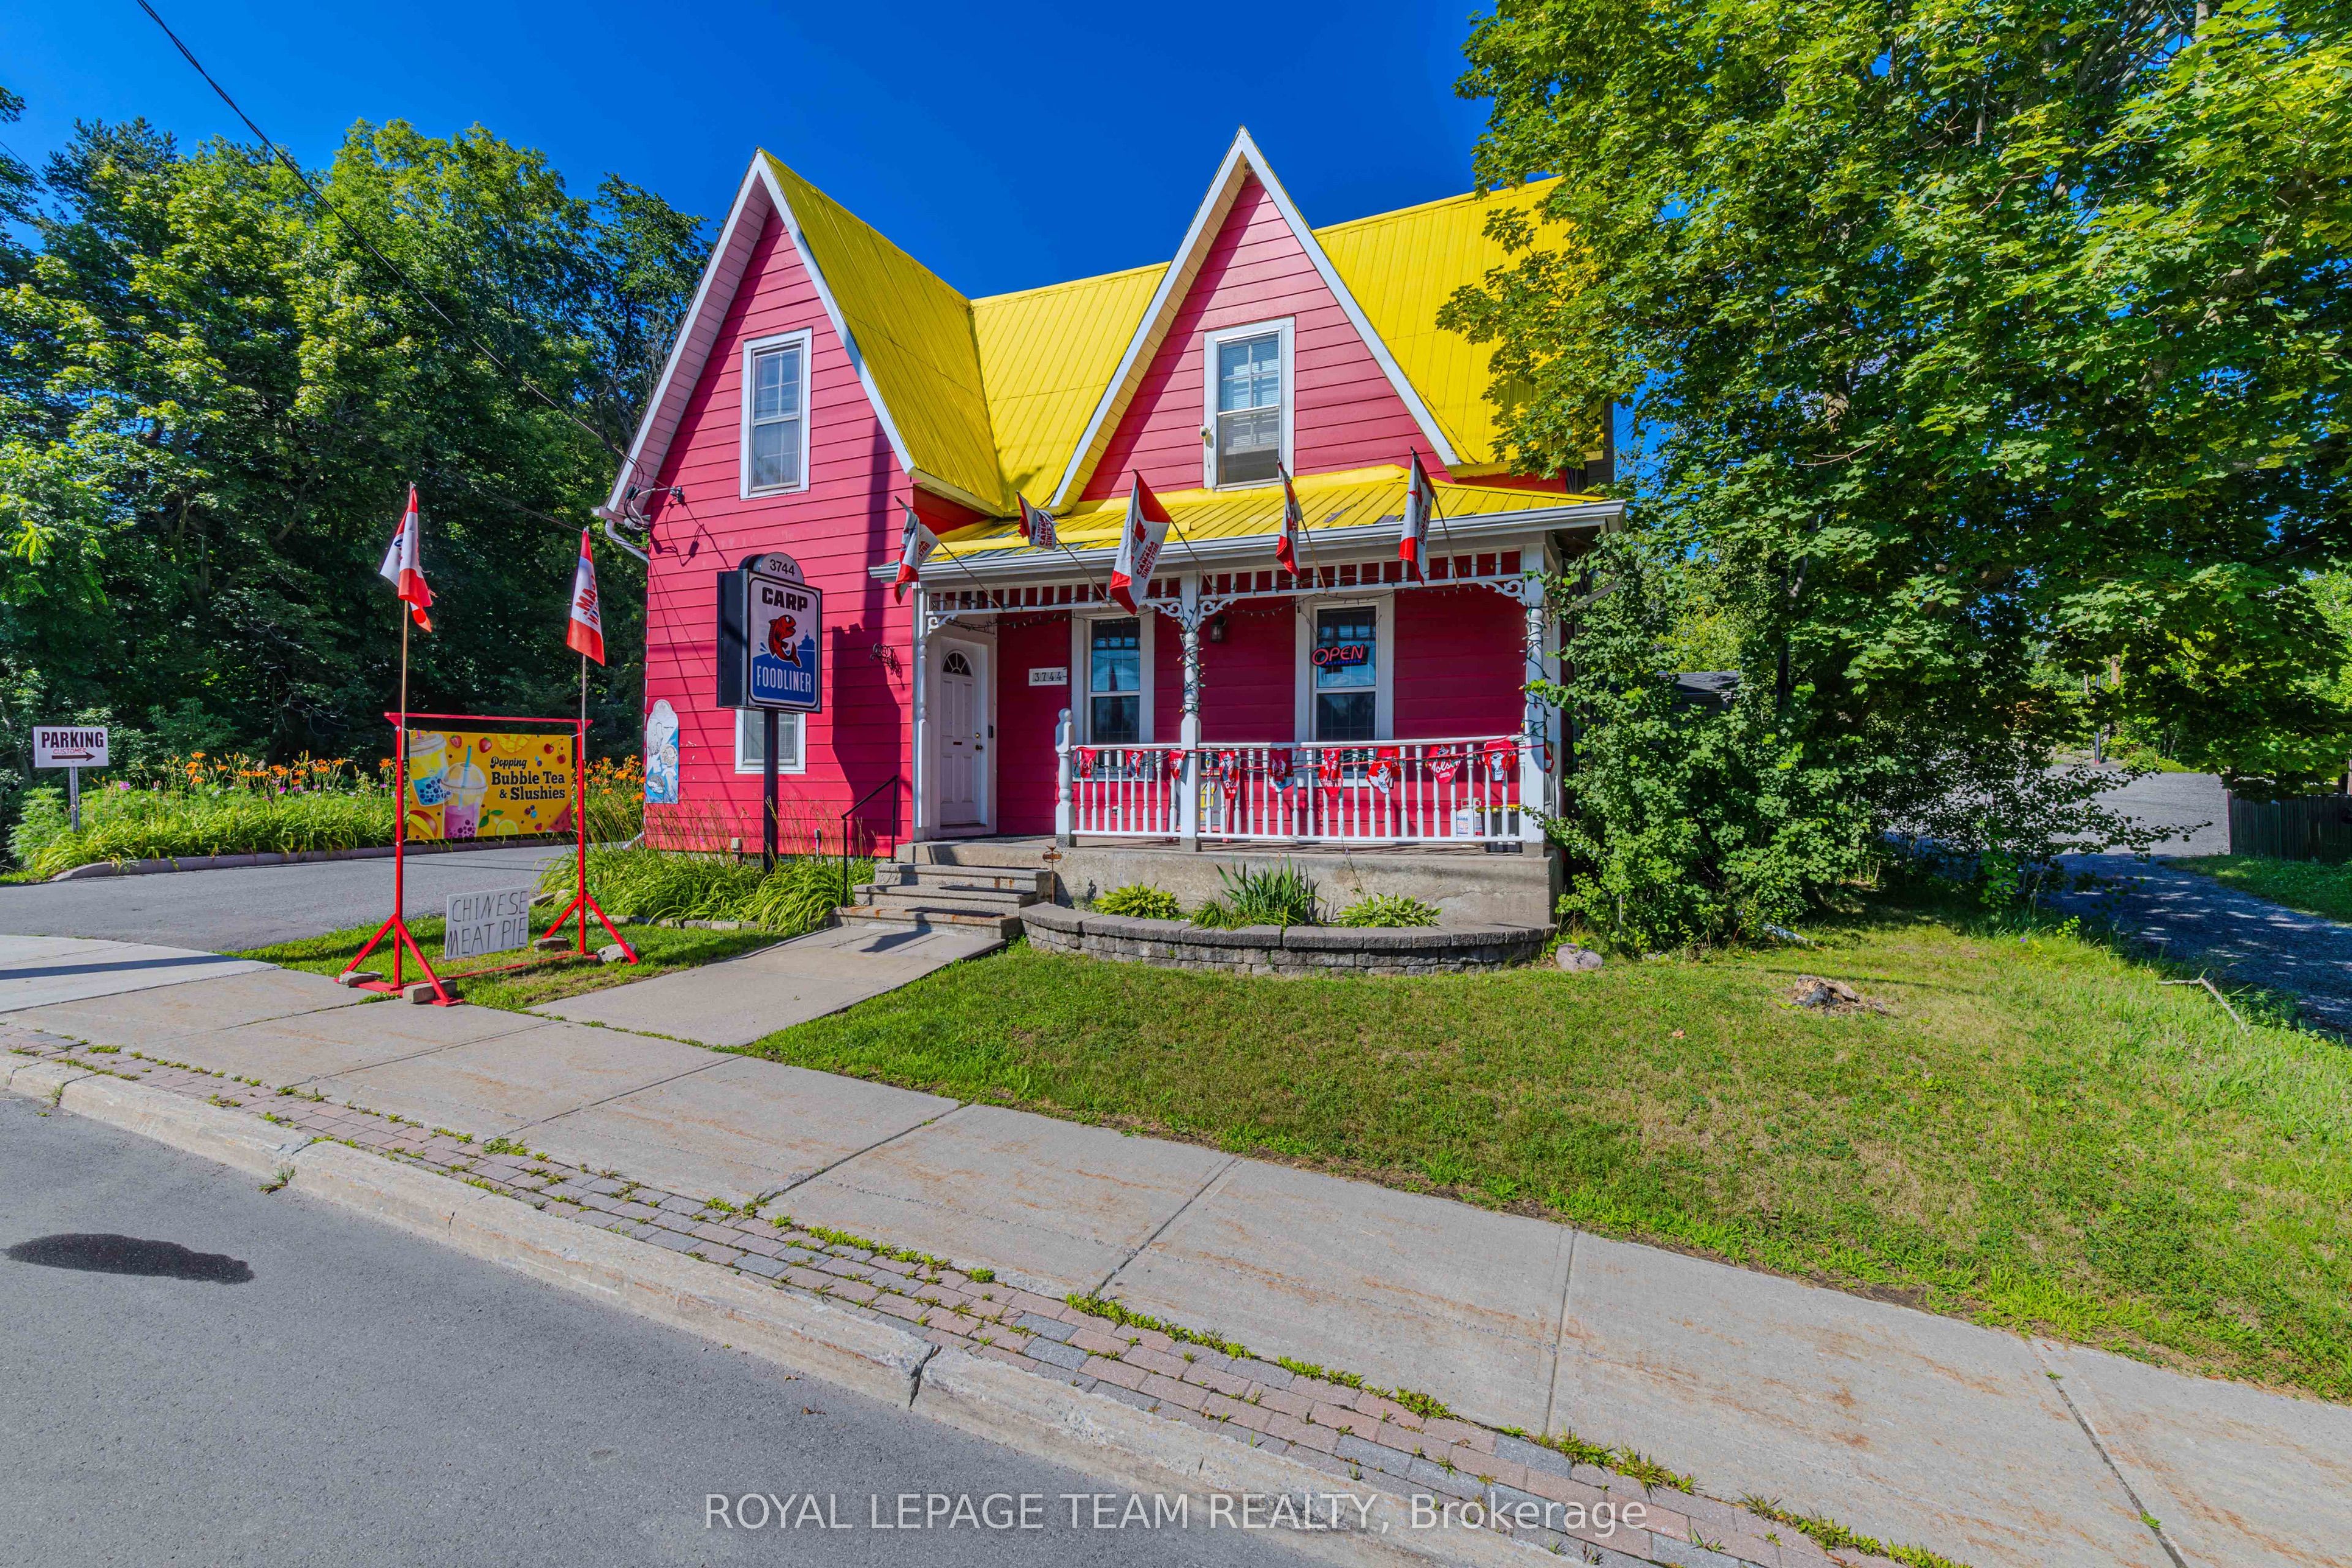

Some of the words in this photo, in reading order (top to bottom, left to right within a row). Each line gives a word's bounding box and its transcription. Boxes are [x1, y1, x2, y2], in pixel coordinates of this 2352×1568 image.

[769, 559, 795, 576] 3744
[1136, 541, 1155, 576] CANADA
[1141, 561, 1153, 579] SINCE
[761, 587, 808, 612] CARP
[1312, 644, 1365, 665] OPEN
[756, 665, 812, 693] FOODLINER
[1034, 671, 1063, 682] 3744
[41, 731, 104, 748] PARKING
[490, 756, 527, 769] Popping
[491, 771, 539, 785] Bubble
[543, 771, 565, 784] Tea
[499, 789, 507, 799] &
[510, 786, 565, 800] Slushies
[452, 891, 528, 922] CHINESE
[446, 923, 495, 956] MEAT
[501, 917, 527, 948] PIE
